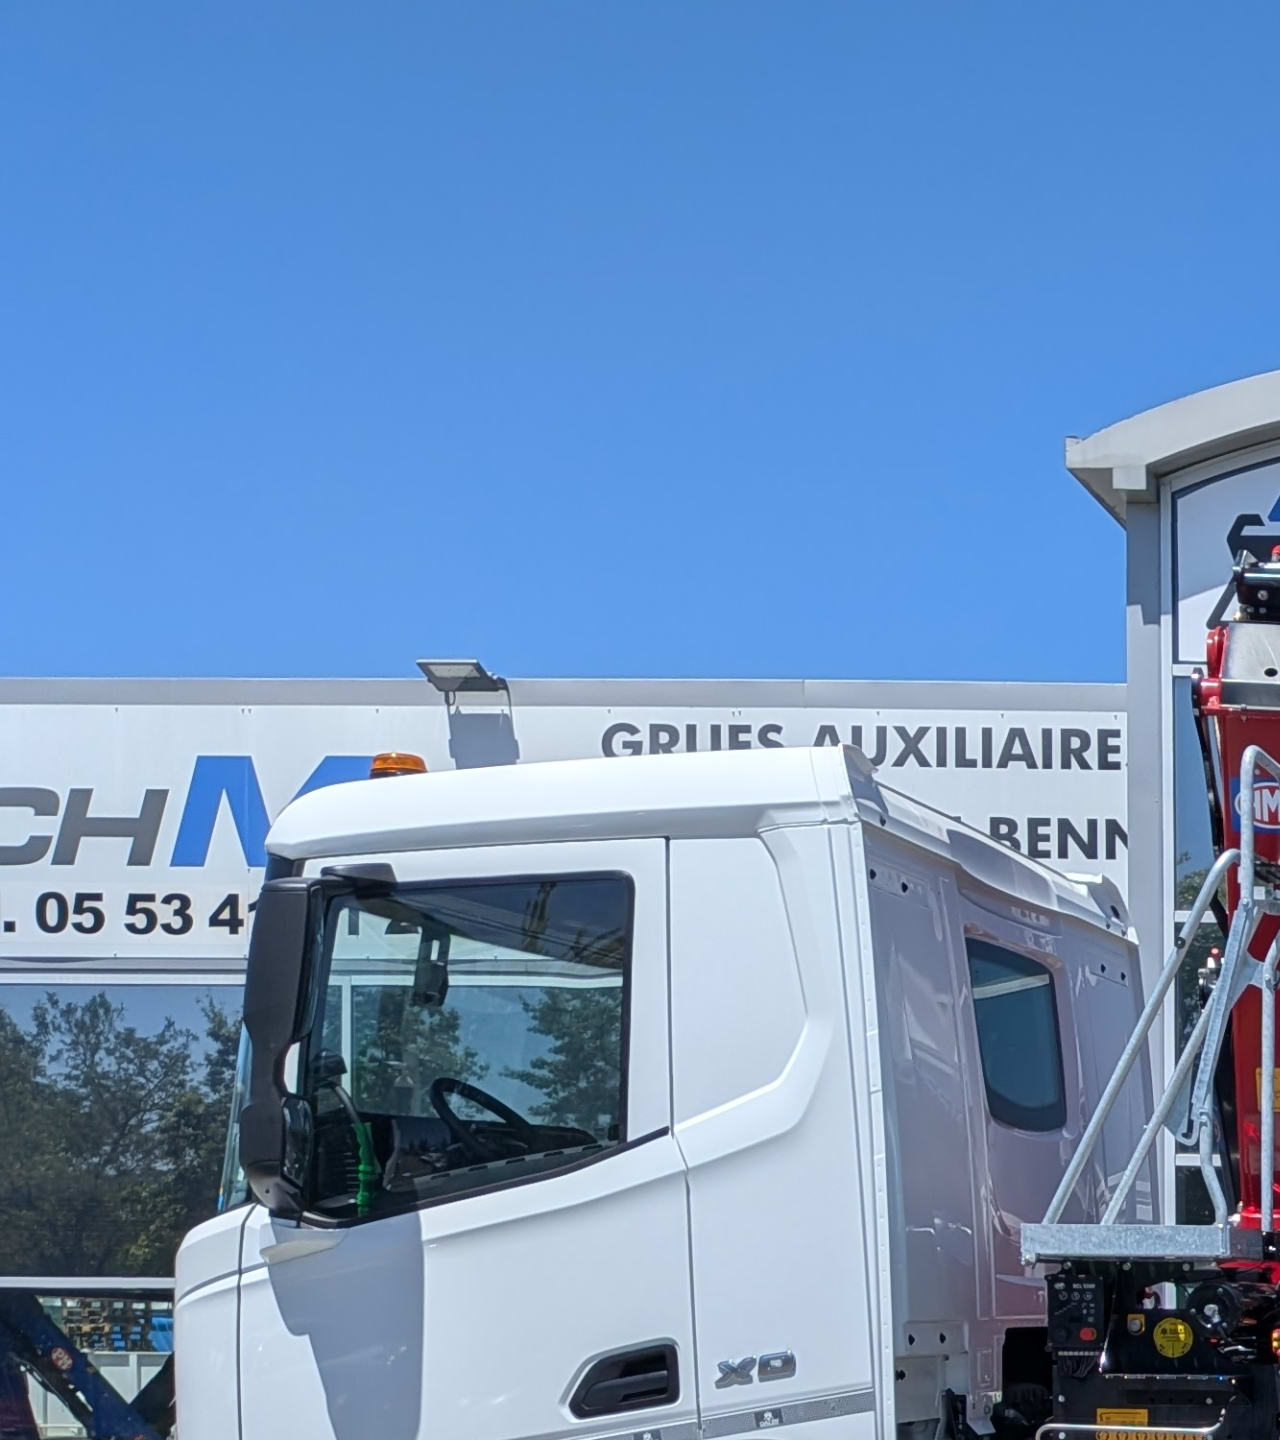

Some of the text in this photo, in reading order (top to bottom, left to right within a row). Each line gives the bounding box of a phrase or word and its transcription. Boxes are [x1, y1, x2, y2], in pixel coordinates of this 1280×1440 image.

[35, 891, 106, 936] 05
[124, 891, 194, 936] 53
[714, 1351, 797, 1390] XD
